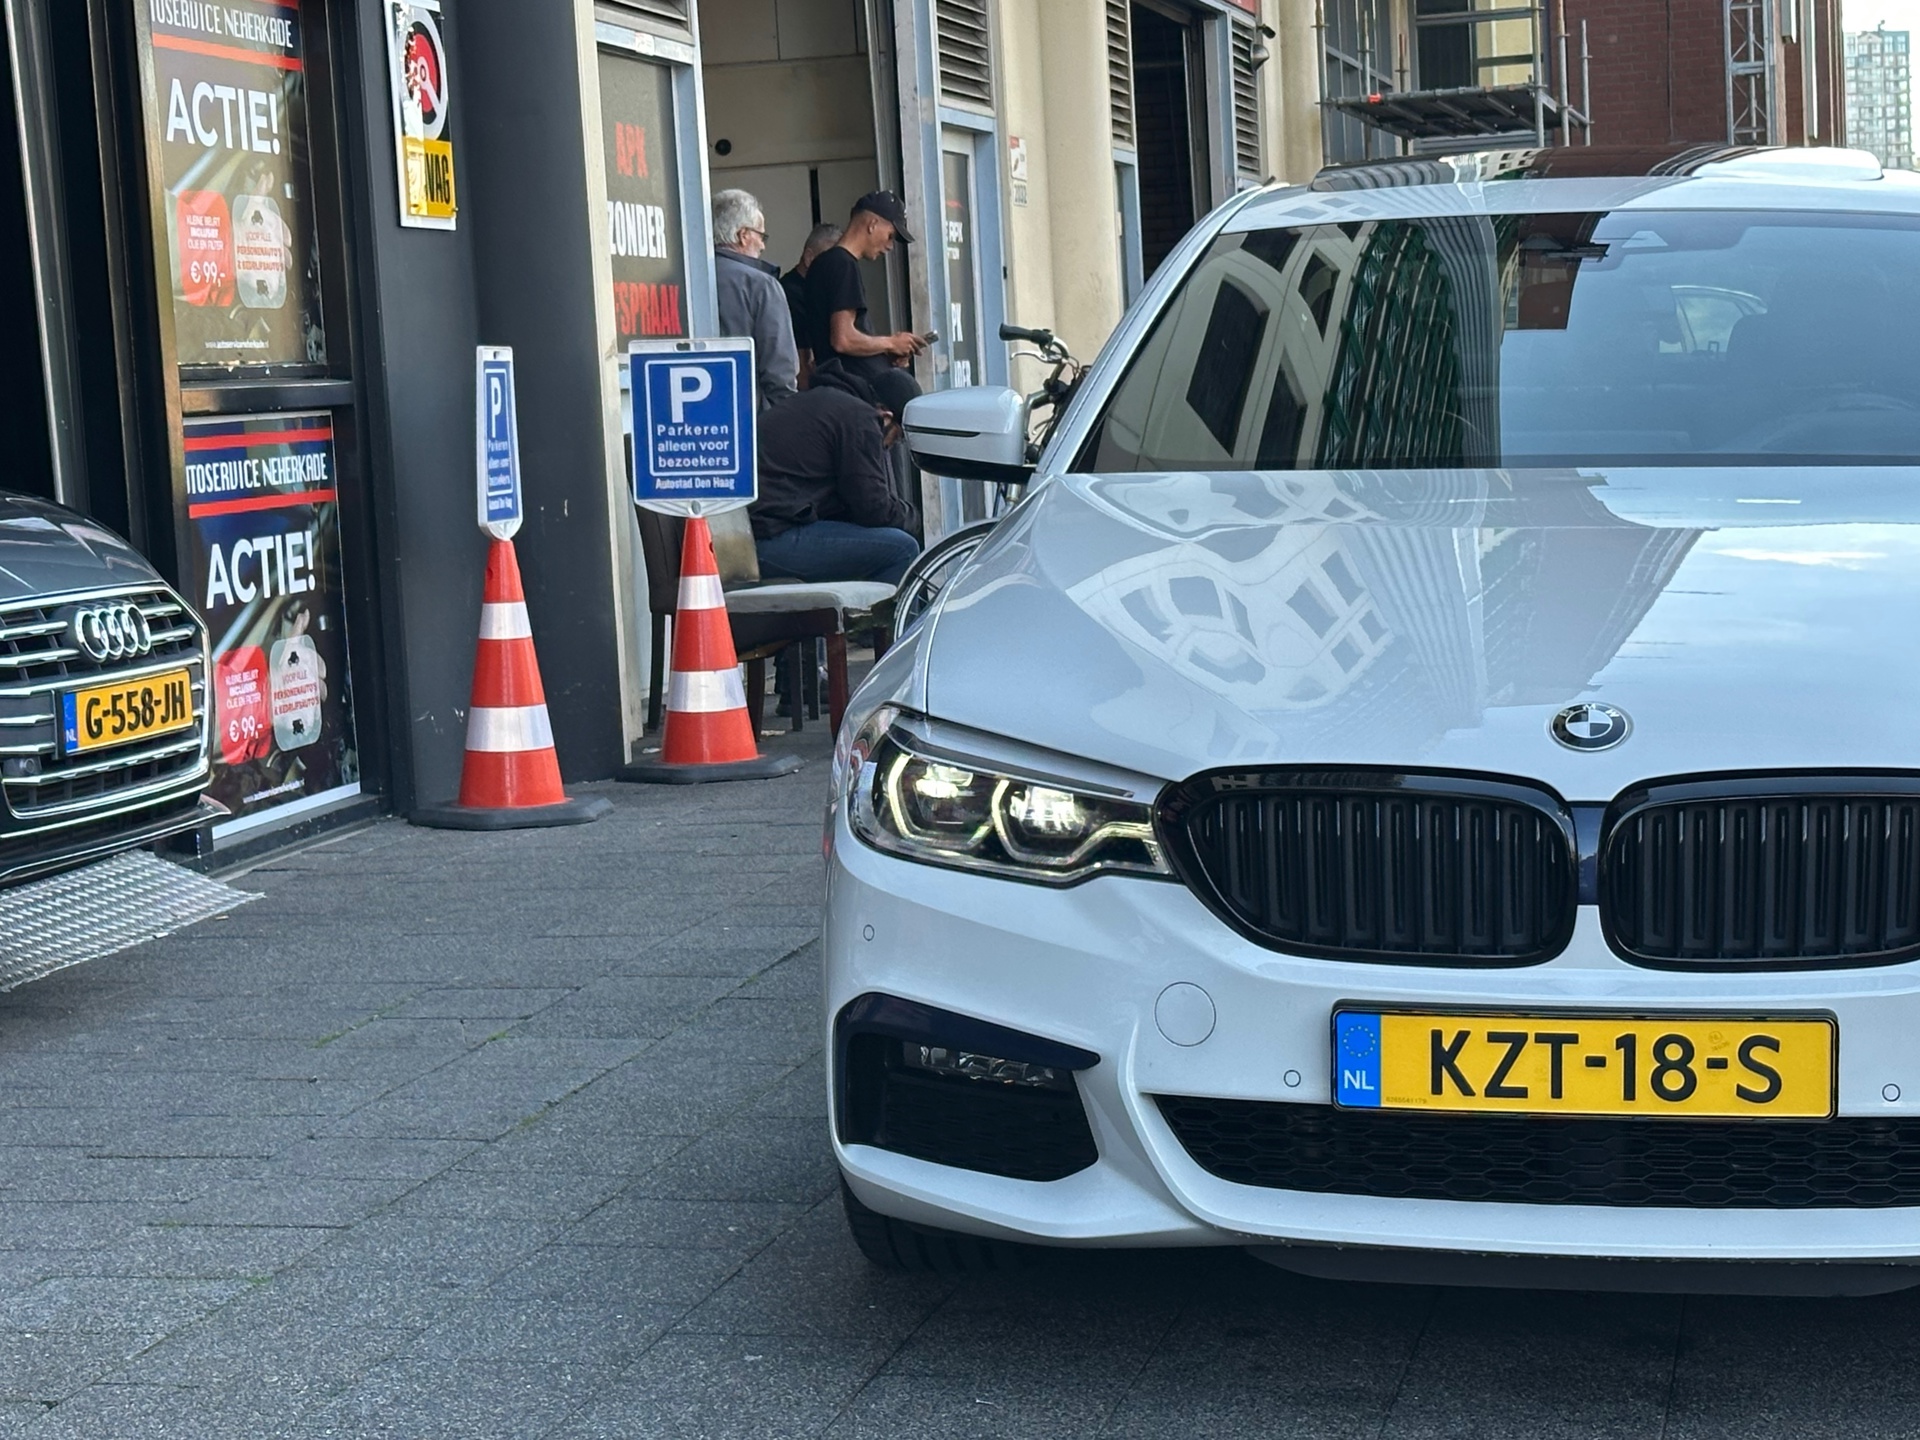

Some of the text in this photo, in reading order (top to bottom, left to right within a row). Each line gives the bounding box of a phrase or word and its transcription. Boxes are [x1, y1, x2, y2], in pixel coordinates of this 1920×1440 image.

[223, 7, 294, 48] NEHERKADE
[166, 78, 281, 155] ACTIE!
[615, 121, 649, 179] APK
[424, 152, 450, 205] VAG
[607, 200, 667, 259] ZONDER
[490, 376, 502, 439] P
[669, 366, 712, 424] P
[657, 423, 729, 436] Parkeren
[657, 440, 730, 452] alleen voor
[262, 452, 328, 487] NEHERKADE
[655, 476, 735, 491] Autostad Den Haag
[658, 455, 730, 468] bezoekers
[206, 530, 316, 609] ACTIE!
[66, 729, 77, 743] NL
[86, 681, 186, 740] G-558-JH
[1343, 1069, 1374, 1090] NL
[1430, 1028, 1783, 1105] KZT-18-S
